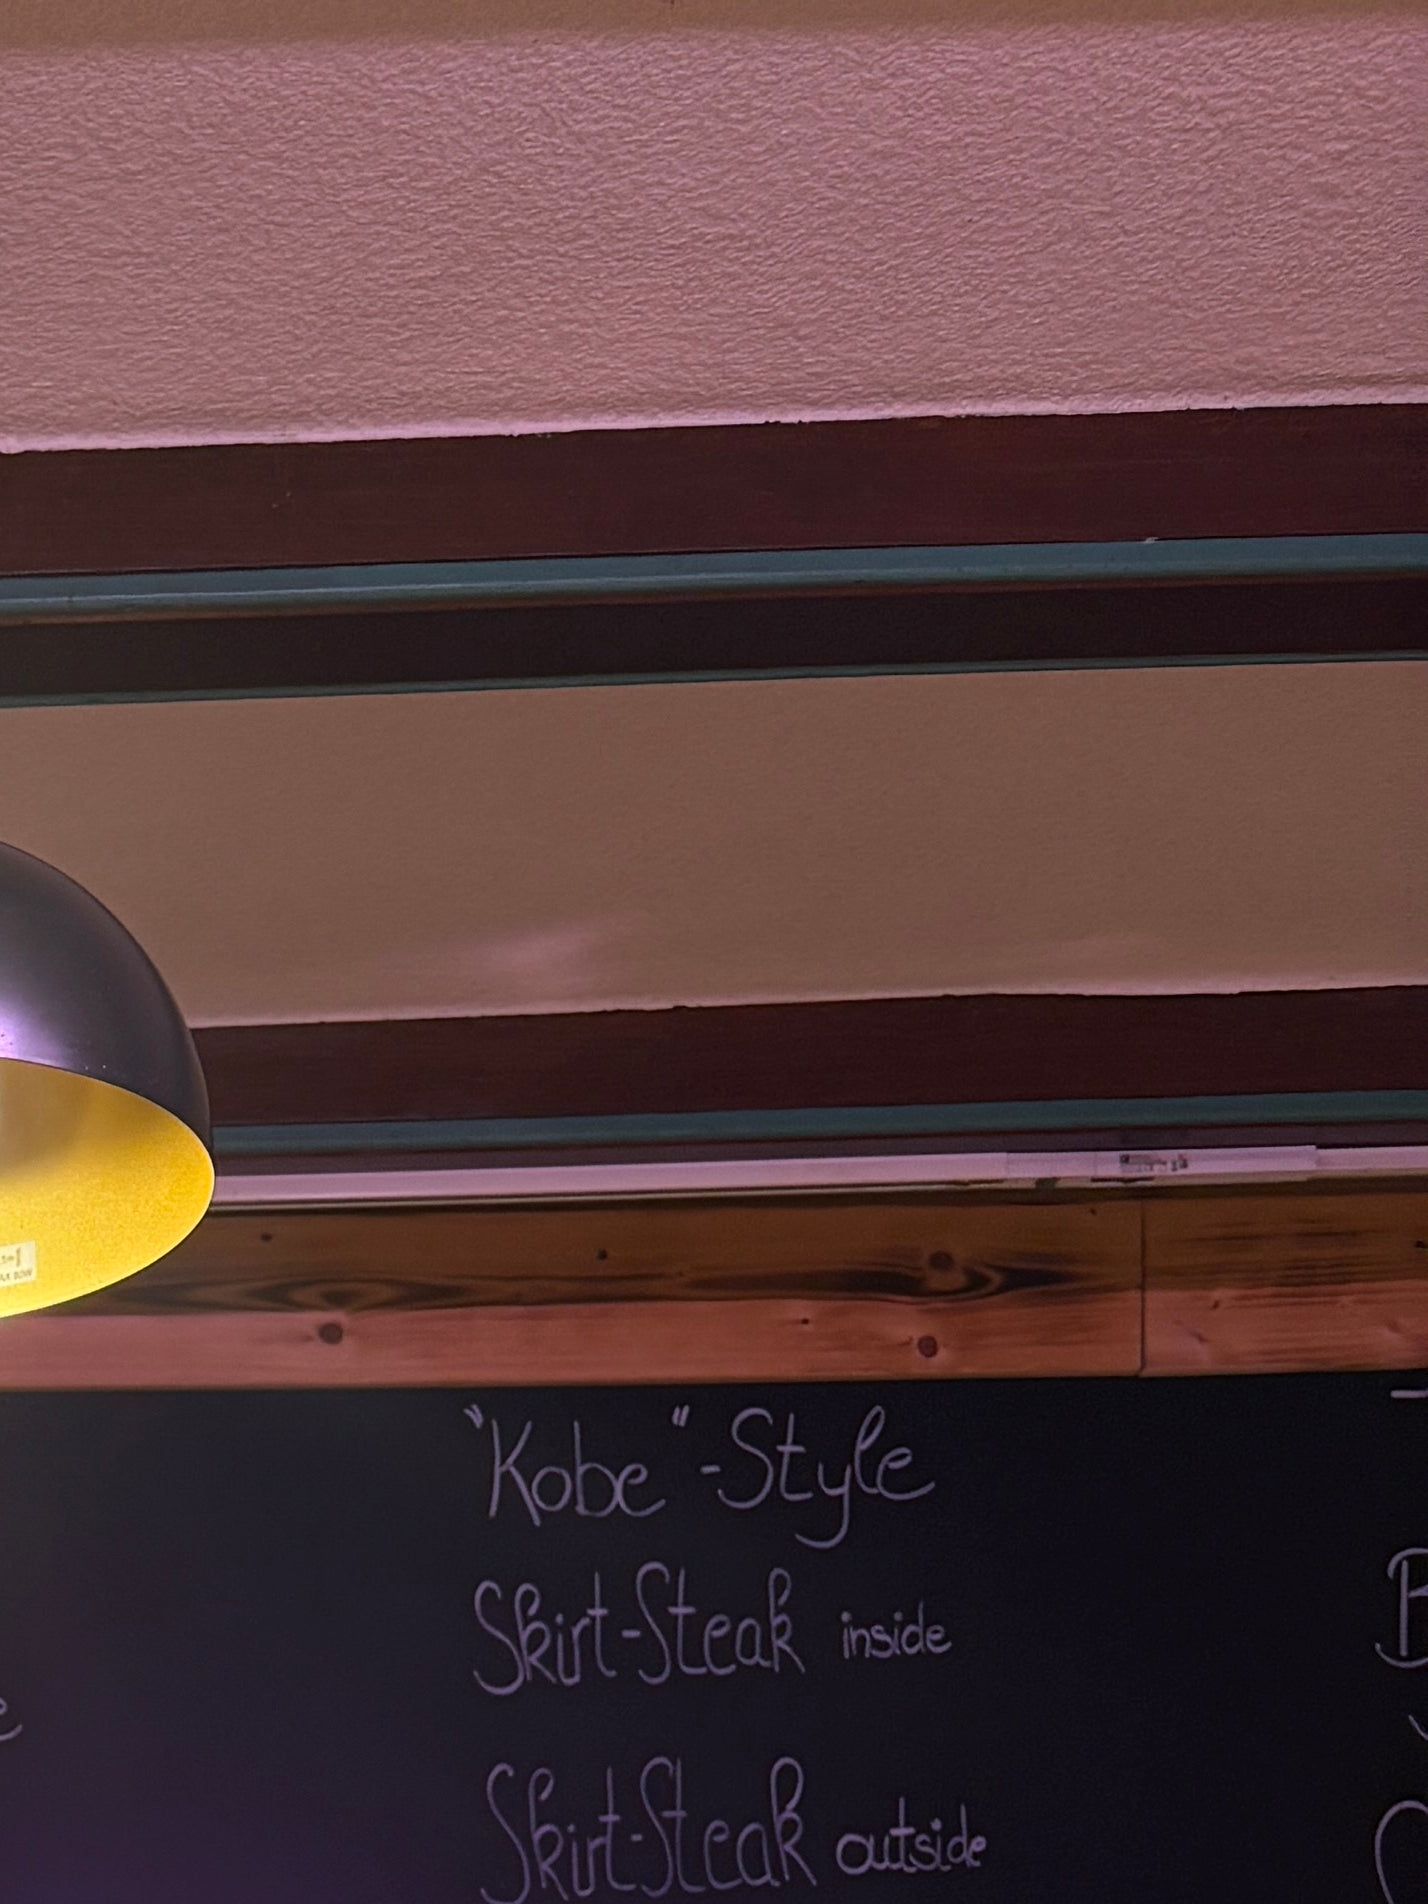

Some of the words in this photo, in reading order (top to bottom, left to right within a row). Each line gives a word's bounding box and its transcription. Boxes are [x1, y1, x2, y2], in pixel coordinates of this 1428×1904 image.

[472, 1560, 806, 1697] Skirt-Steak
[840, 1601, 954, 1660] inside
[834, 1796, 989, 1877] outside
